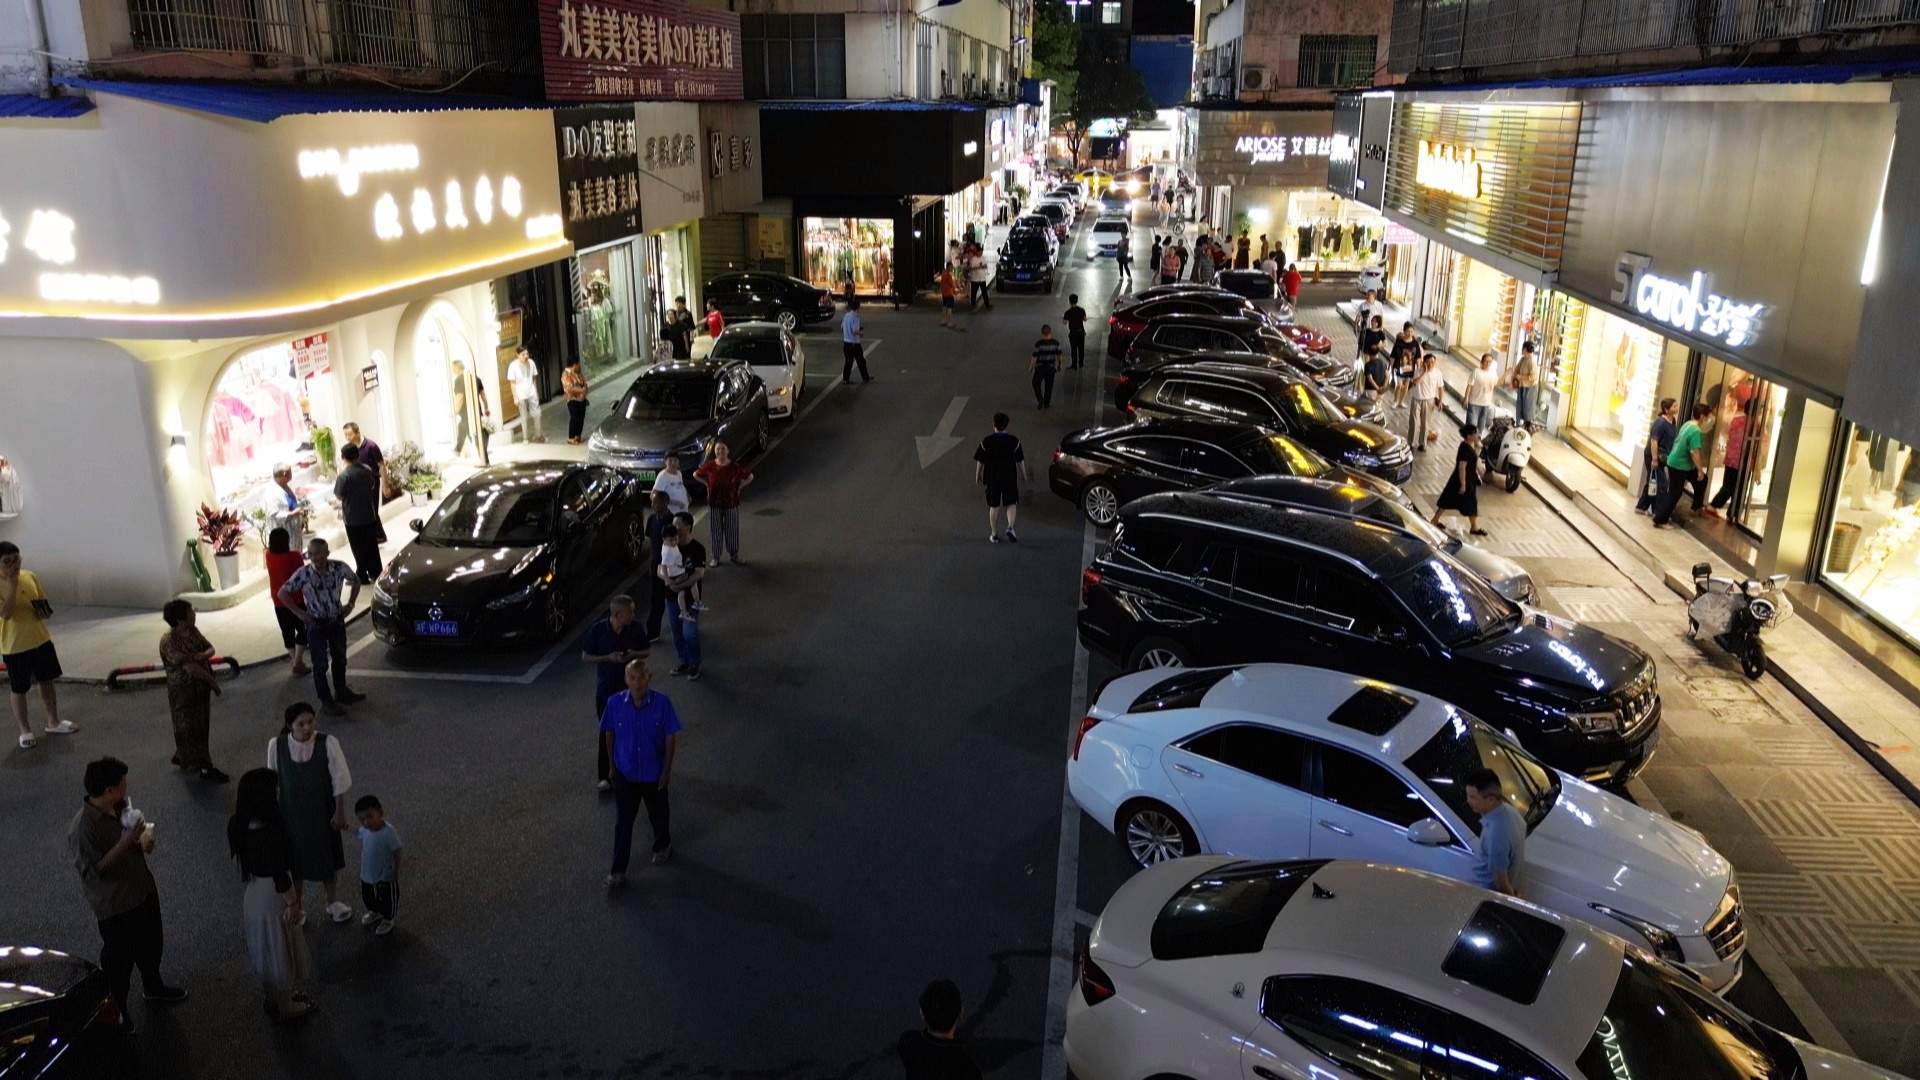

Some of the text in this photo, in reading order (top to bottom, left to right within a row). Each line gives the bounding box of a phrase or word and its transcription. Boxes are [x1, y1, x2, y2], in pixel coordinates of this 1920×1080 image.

[558, 0, 733, 69] 丸美美容美体SPA养生馆
[1235, 136, 1286, 152] ARIOSE
[567, 171, 638, 222] 丸美美容美体
